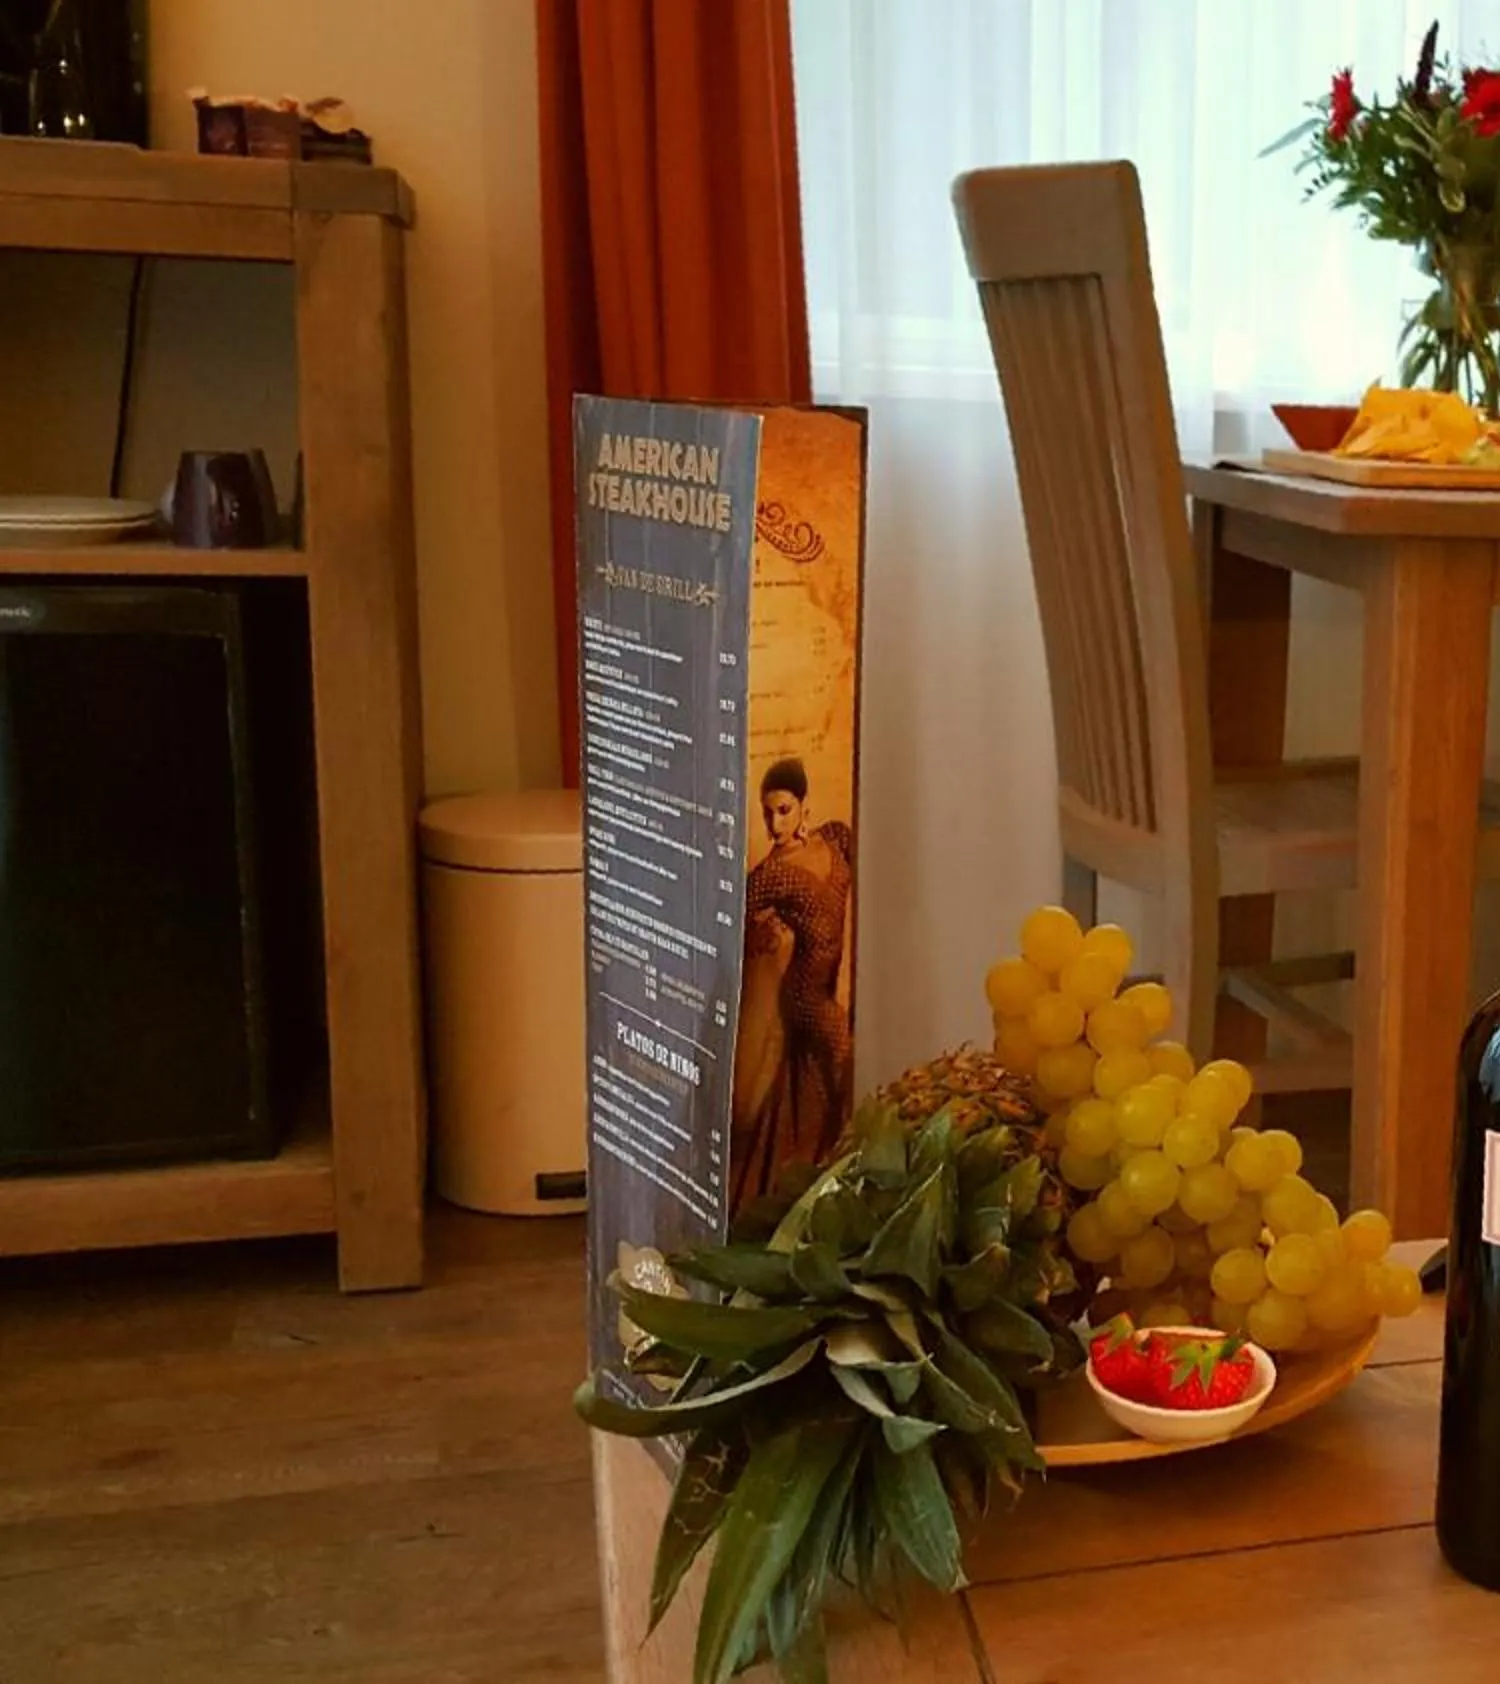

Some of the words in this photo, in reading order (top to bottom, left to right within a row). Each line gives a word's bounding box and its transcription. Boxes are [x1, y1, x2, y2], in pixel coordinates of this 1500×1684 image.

[598, 433, 719, 485] AMERICAN
[588, 473, 732, 532] STEAKHOUSE
[617, 1021, 655, 1060] PLATOS
[655, 1043, 669, 1068] DE
